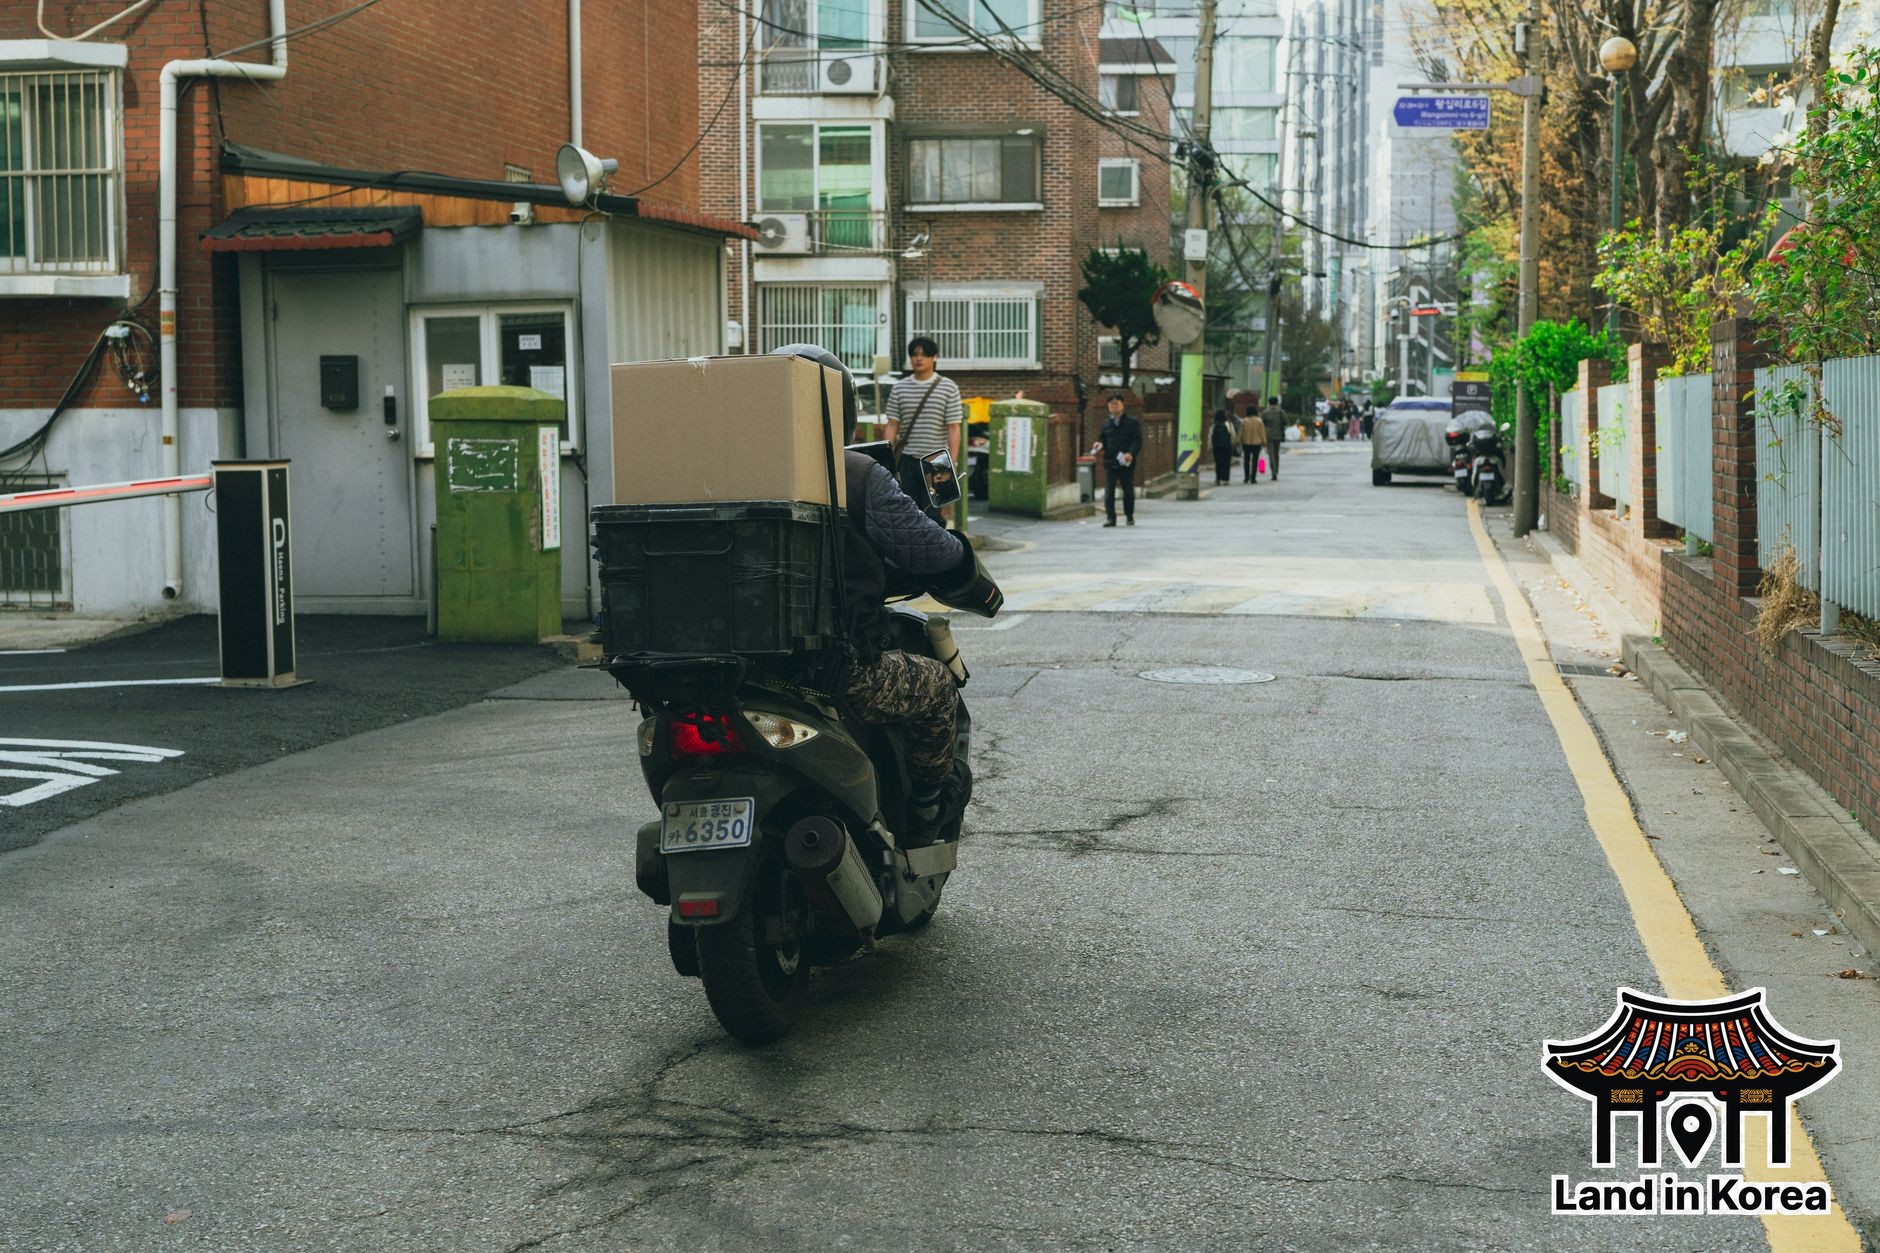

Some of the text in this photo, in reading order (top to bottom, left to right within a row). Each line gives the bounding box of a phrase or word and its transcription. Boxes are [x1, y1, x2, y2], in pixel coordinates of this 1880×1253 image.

[689, 804, 731, 818] 서울 광진
[685, 818, 745, 842] 6350
